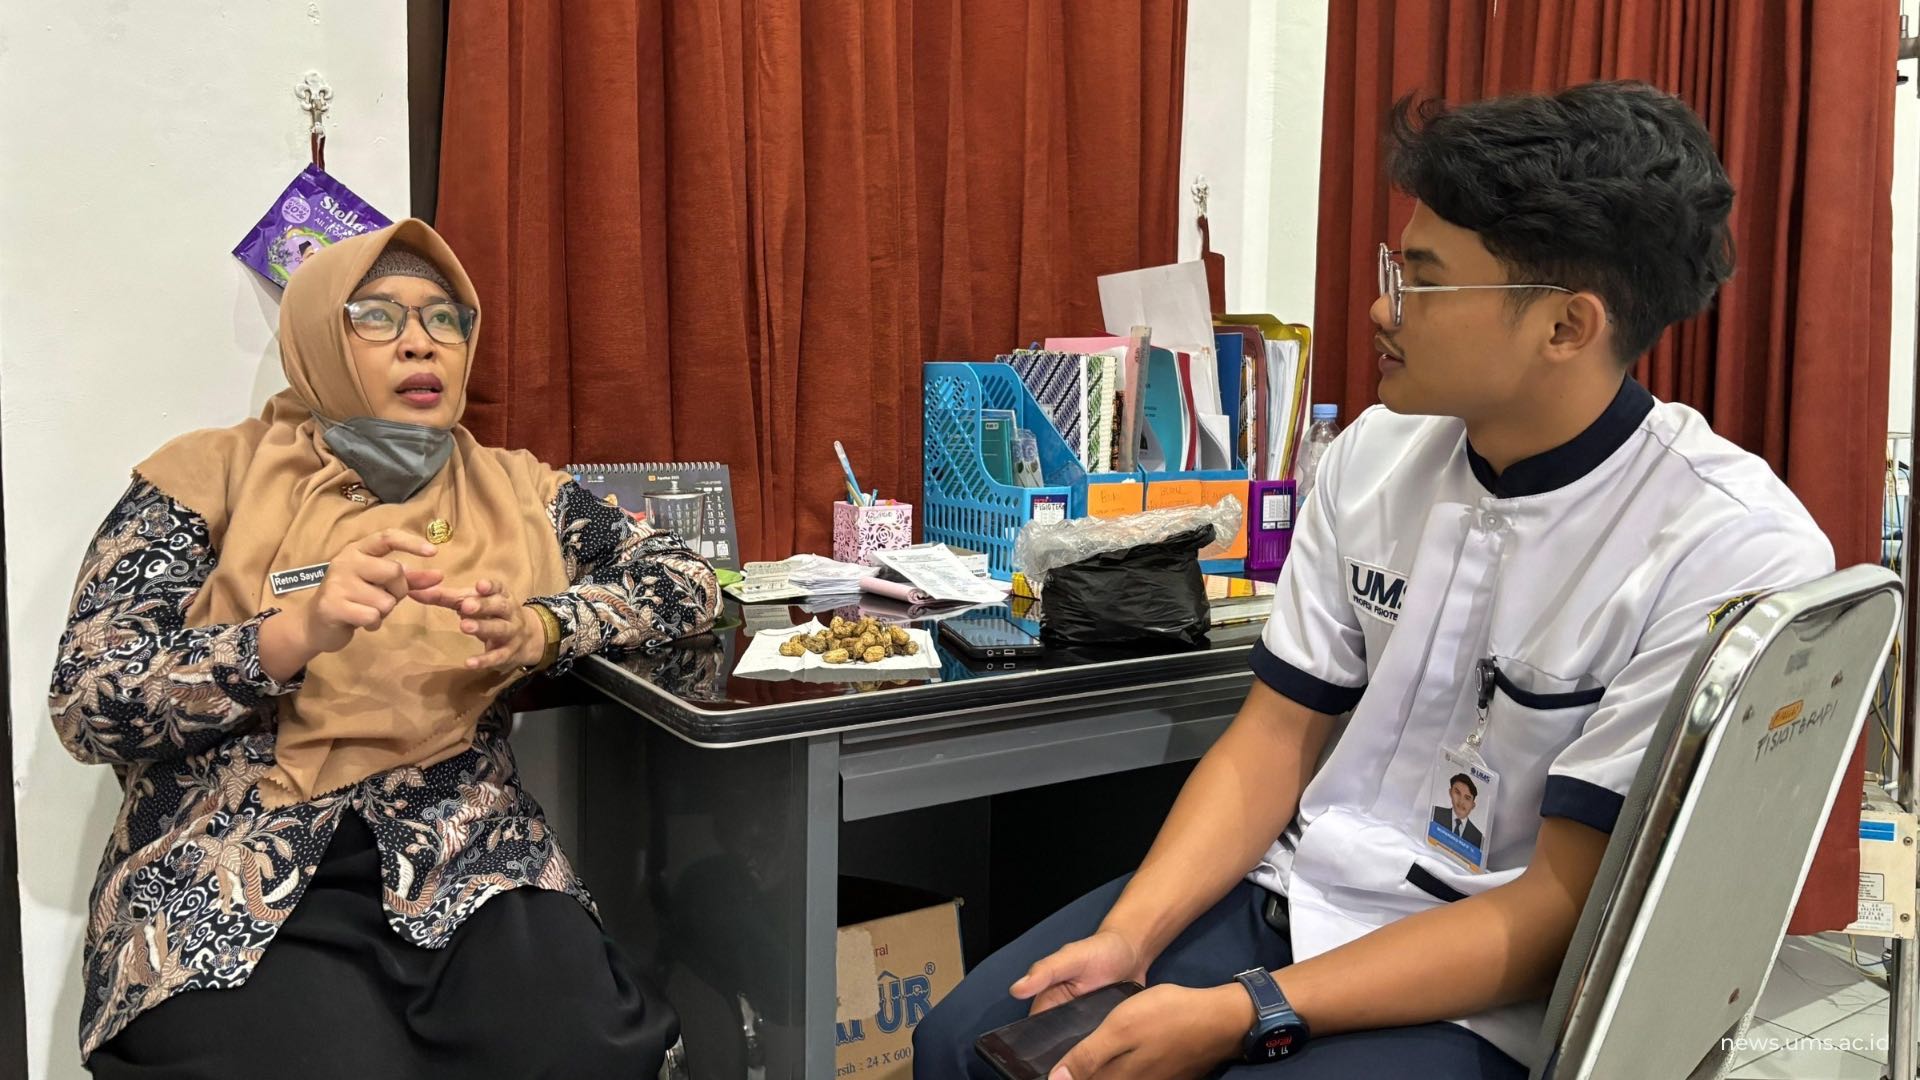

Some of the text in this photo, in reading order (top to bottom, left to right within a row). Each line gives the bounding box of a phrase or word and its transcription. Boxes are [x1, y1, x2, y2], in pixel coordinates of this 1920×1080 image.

[320, 196, 366, 232] Stella
[274, 568, 325, 586] Retno Sayuti
[1350, 563, 1408, 610] UM
[867, 1056, 878, 1068] 24
[882, 1052, 891, 1065] X
[894, 1047, 912, 1060] 600
